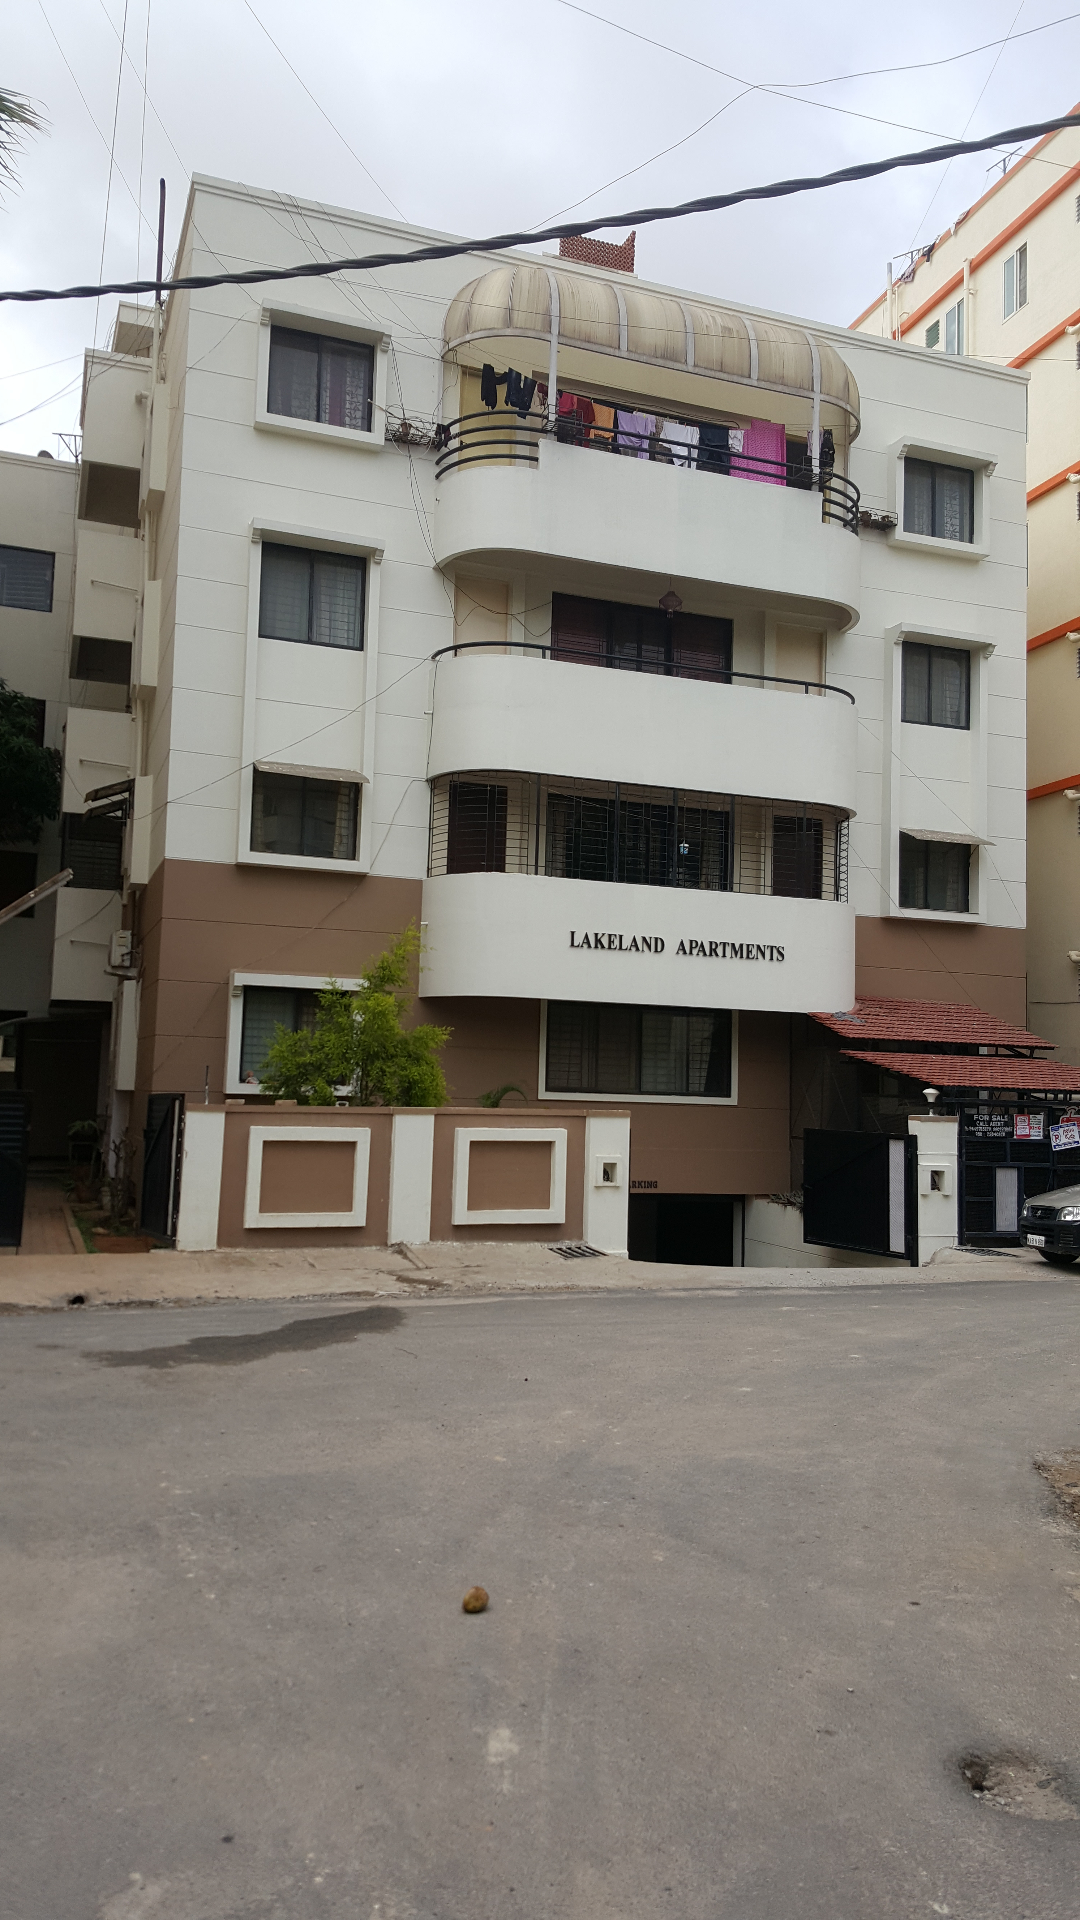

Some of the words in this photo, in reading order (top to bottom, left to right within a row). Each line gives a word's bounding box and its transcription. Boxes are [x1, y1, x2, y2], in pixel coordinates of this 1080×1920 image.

[569, 930, 665, 953] LAKELAND
[675, 938, 785, 962] APARTMENTS
[991, 1114, 1009, 1122] SALE
